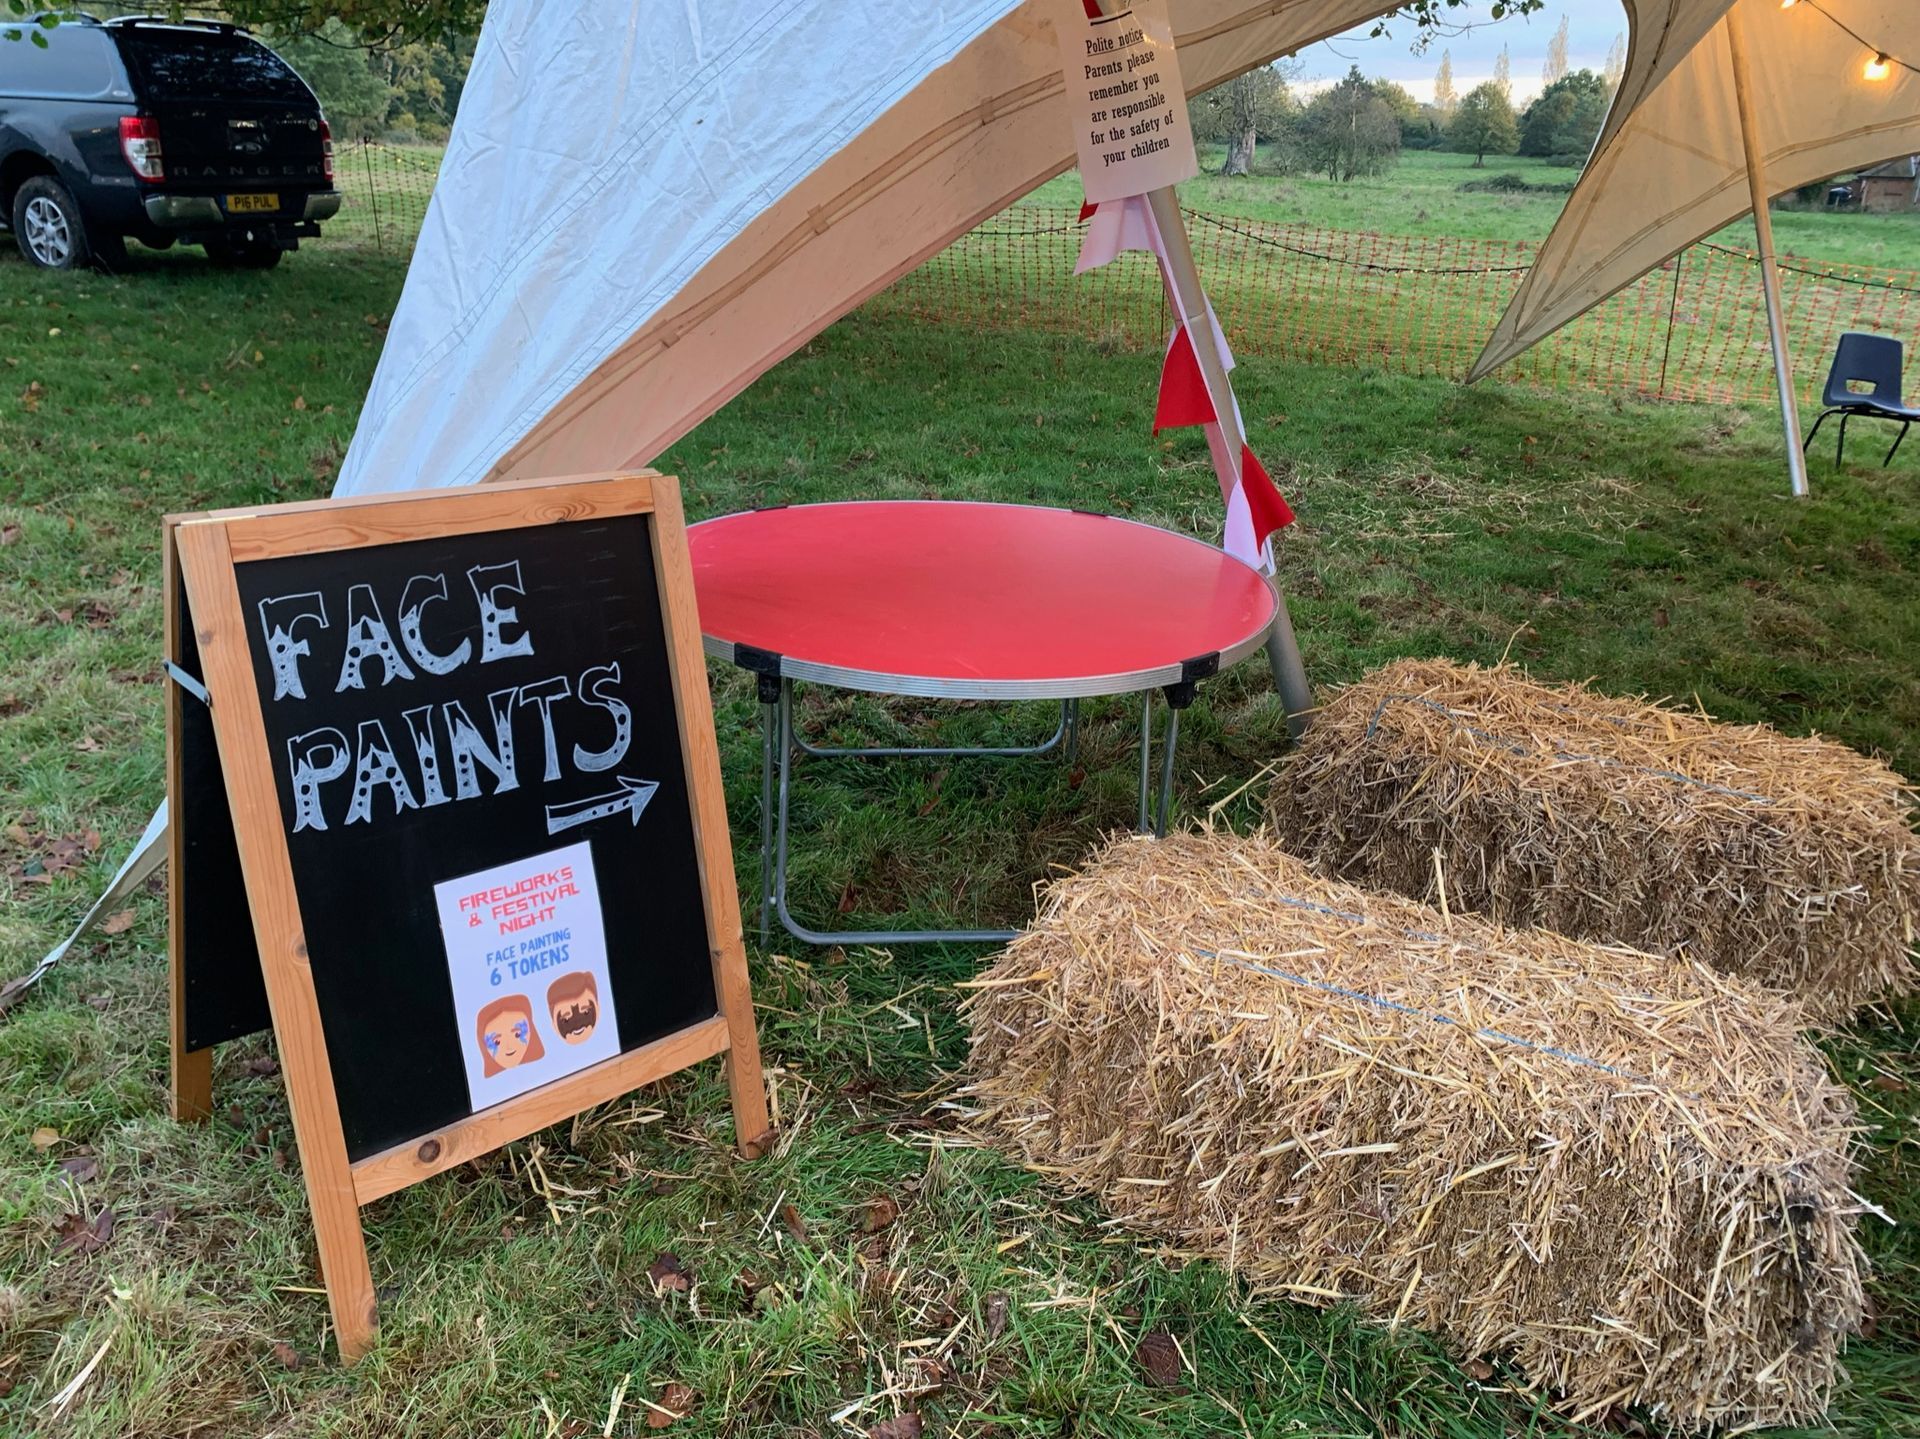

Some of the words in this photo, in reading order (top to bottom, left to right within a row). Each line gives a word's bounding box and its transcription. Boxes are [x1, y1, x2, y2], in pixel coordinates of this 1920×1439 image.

[1086, 37, 1114, 54] Polite
[1119, 28, 1144, 47] notice
[1084, 59, 1123, 79] Parents
[1127, 50, 1155, 73] please
[1089, 80, 1139, 101] remember
[1142, 73, 1160, 90] you
[1091, 109, 1107, 123] are
[1112, 91, 1166, 121] responsible
[1090, 131, 1105, 145] for
[1109, 127, 1126, 142] the
[1130, 117, 1160, 137] safety
[1164, 110, 1174, 125] of
[1102, 150, 1126, 167] your
[1130, 137, 1170, 159] children
[173, 165, 320, 177] RANGER
[234, 196, 251, 209] P16
[253, 195, 272, 208] PUL
[258, 560, 535, 701] FACE
[287, 661, 632, 833] PAINTS
[459, 866, 573, 913] FIREWORKS
[469, 913, 482, 928] &
[492, 882, 581, 920] FESTIVAL
[500, 906, 556, 936] NIGHT
[486, 947, 515, 967] FACE
[520, 927, 571, 954] PAINTING
[490, 967, 502, 987] 6
[508, 944, 570, 981] TOKENS
